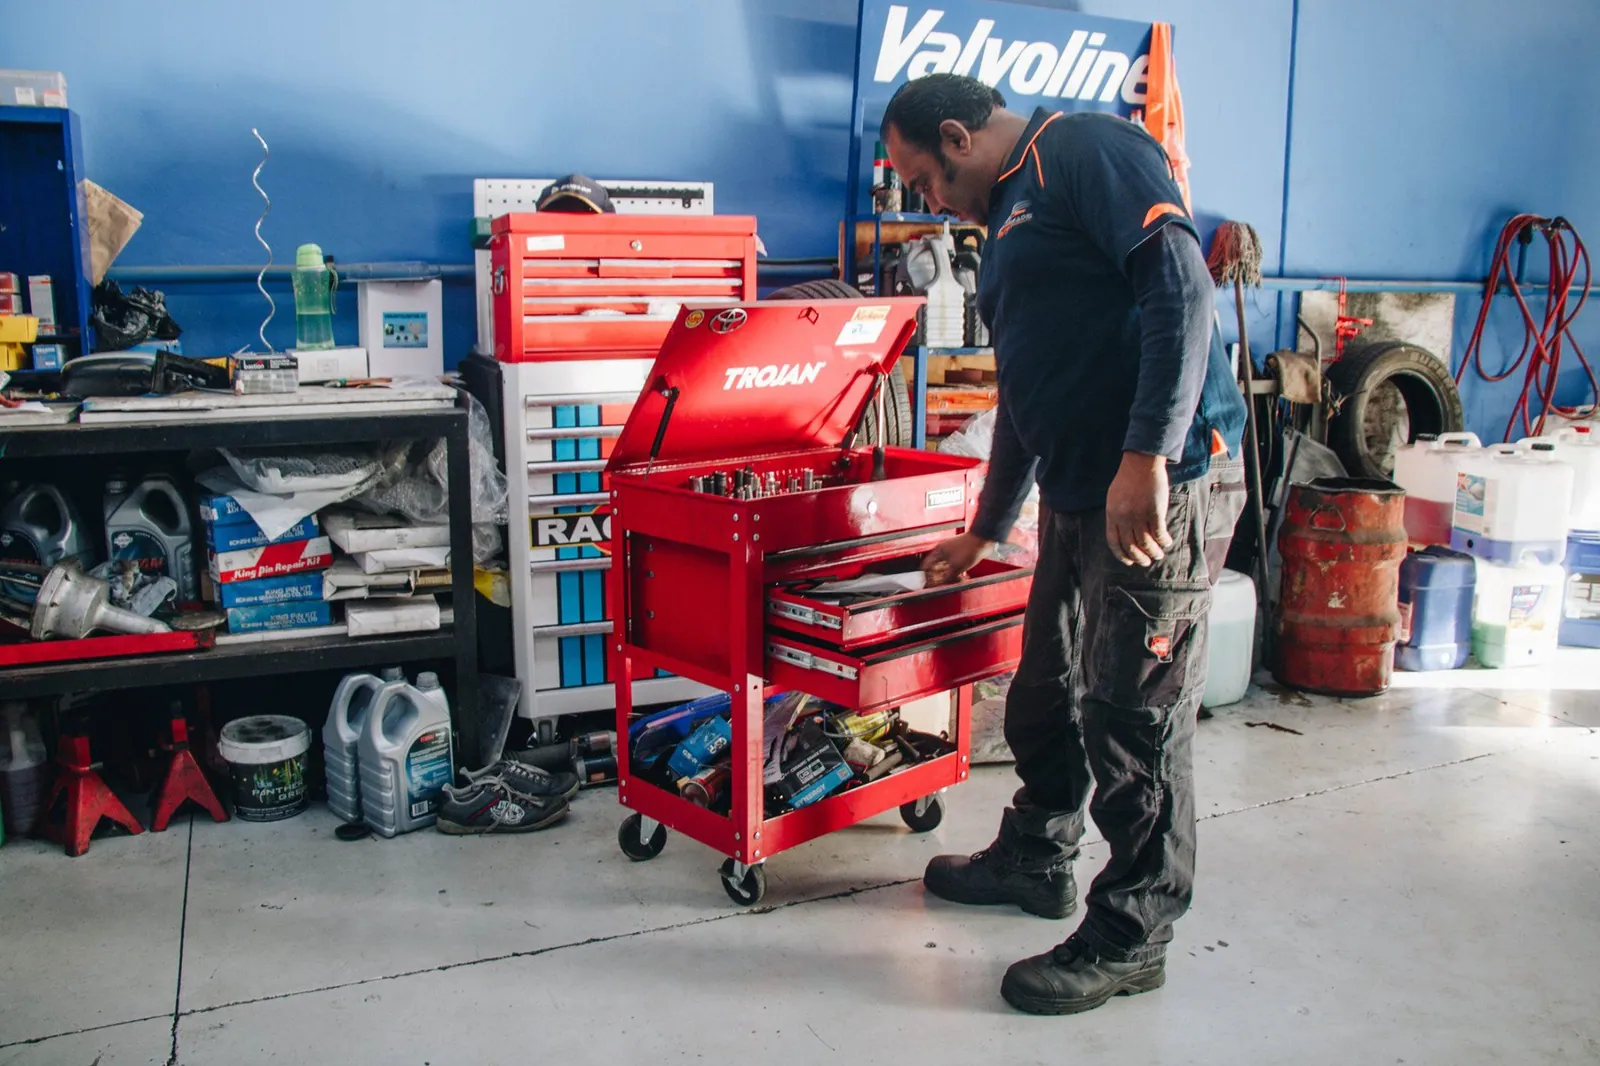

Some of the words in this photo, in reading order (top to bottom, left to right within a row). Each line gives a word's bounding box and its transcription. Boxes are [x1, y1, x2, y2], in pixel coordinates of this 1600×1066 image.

[874, 5, 1149, 104] Valvoline
[723, 362, 826, 390] TROJAN
[232, 568, 256, 580] King
[258, 565, 273, 577] Pin
[275, 560, 305, 573] Repair
[307, 556, 321, 566] Kit
[252, 780, 303, 798] PANTHER
[794, 783, 826, 808] SYNERGY
